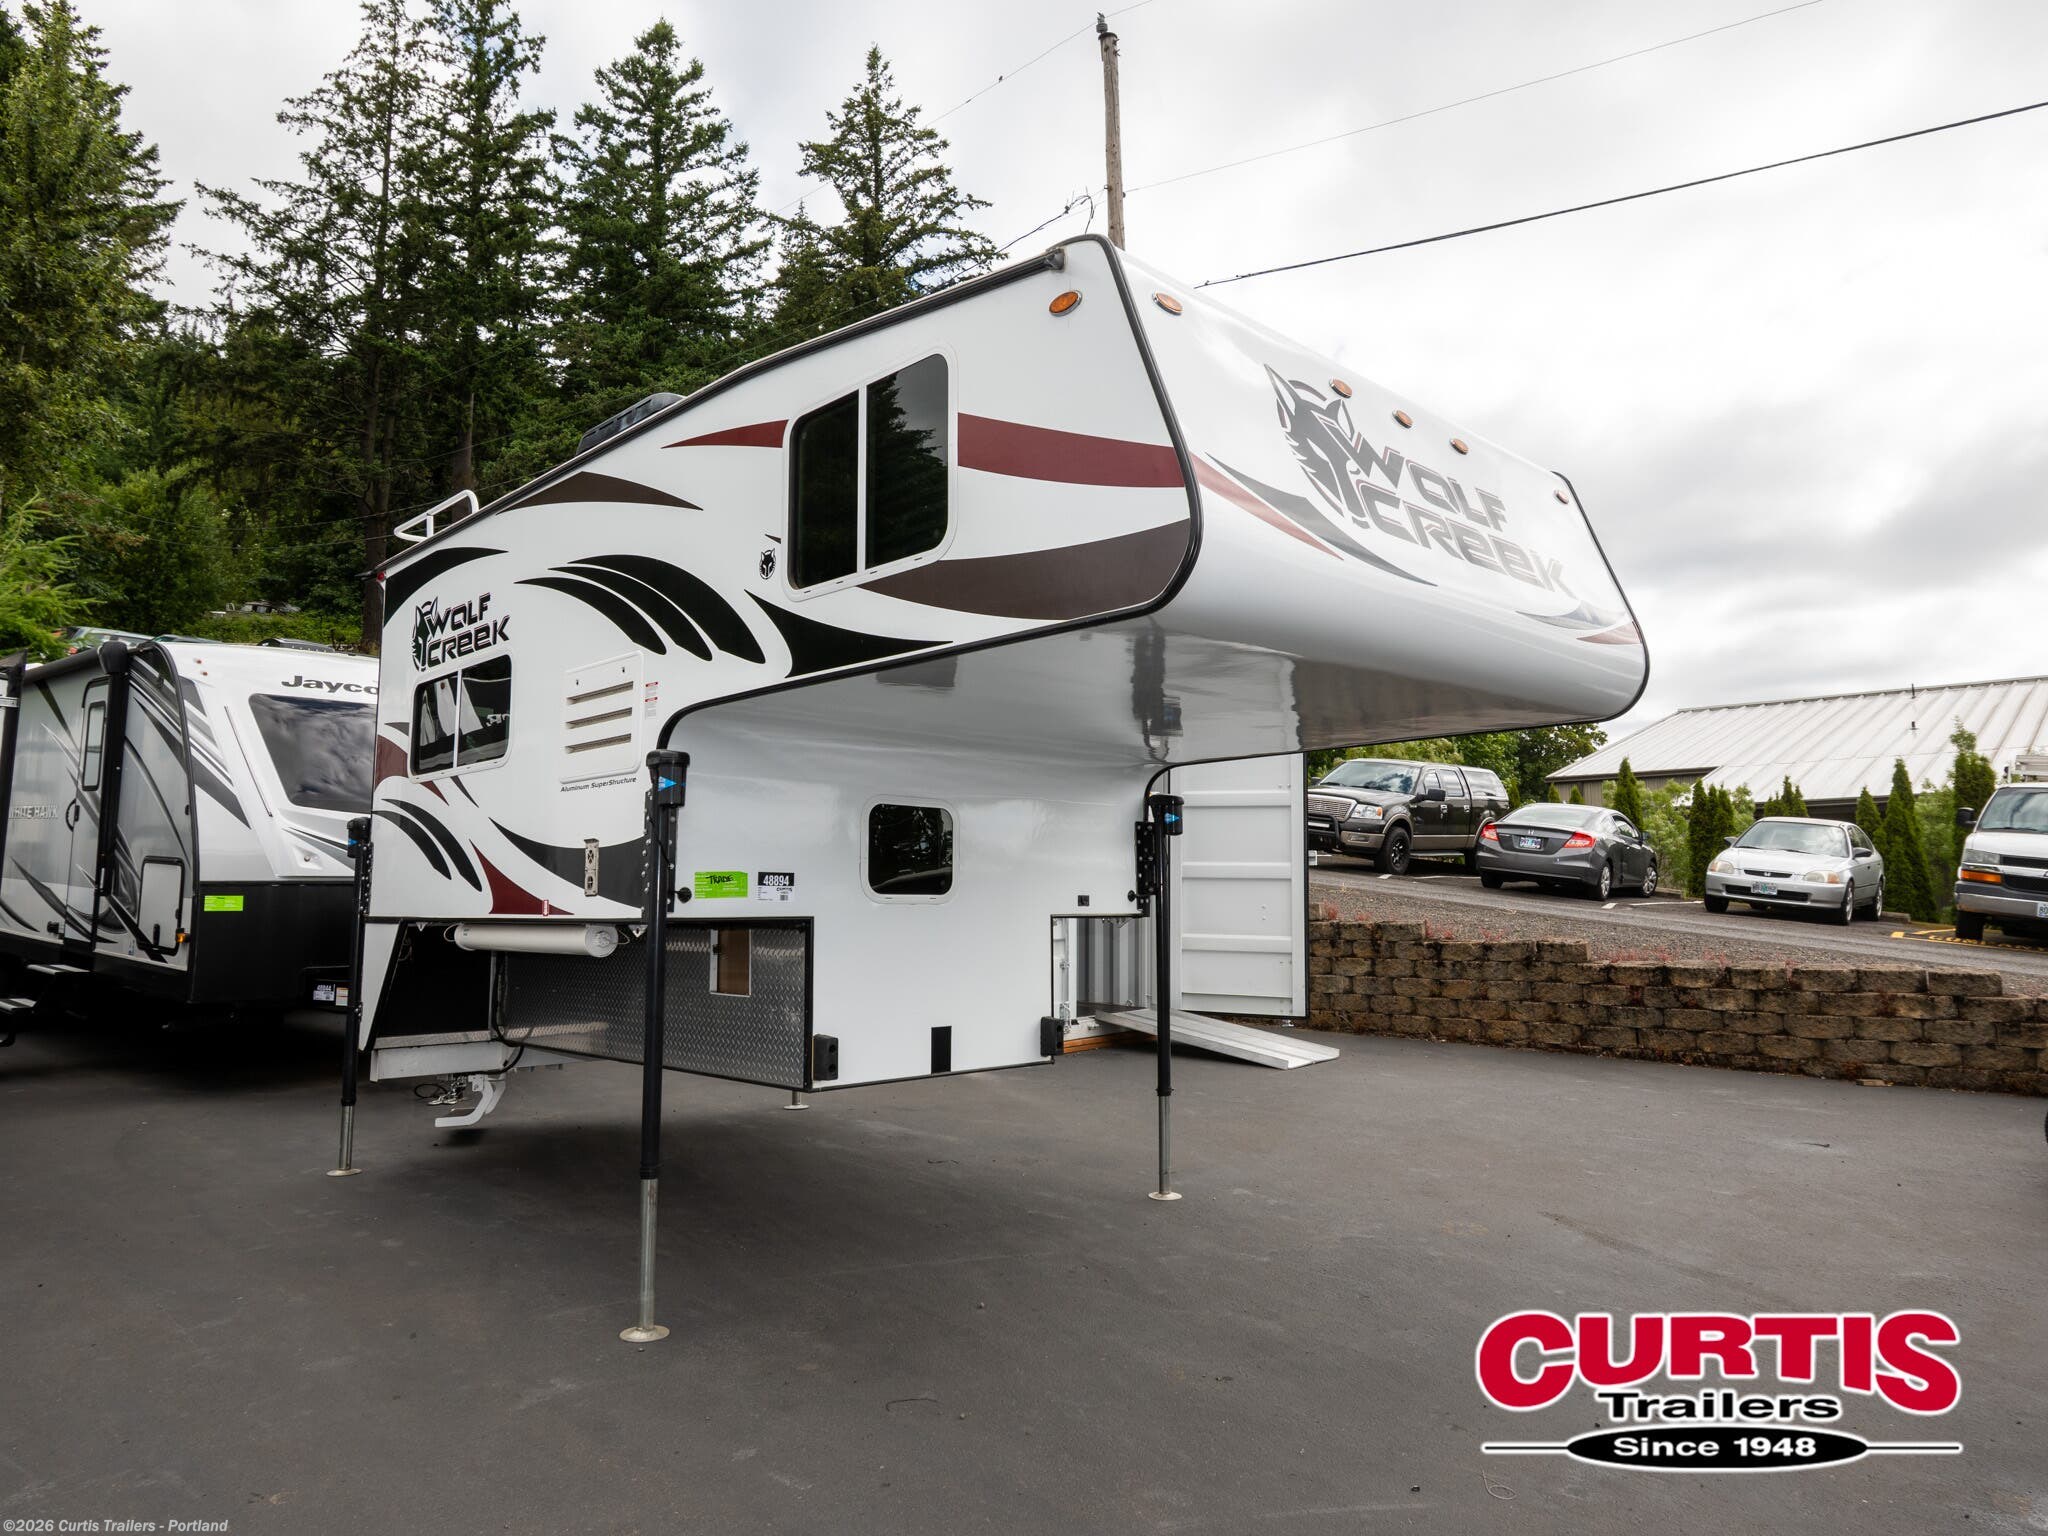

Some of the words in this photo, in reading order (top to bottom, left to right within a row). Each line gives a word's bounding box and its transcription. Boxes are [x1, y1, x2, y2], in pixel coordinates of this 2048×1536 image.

[1316, 415, 1508, 532] WOLF
[428, 592, 490, 637] WOLF
[281, 675, 378, 695] Jayco
[560, 784, 590, 793] Aluminum
[763, 874, 789, 886] 48894
